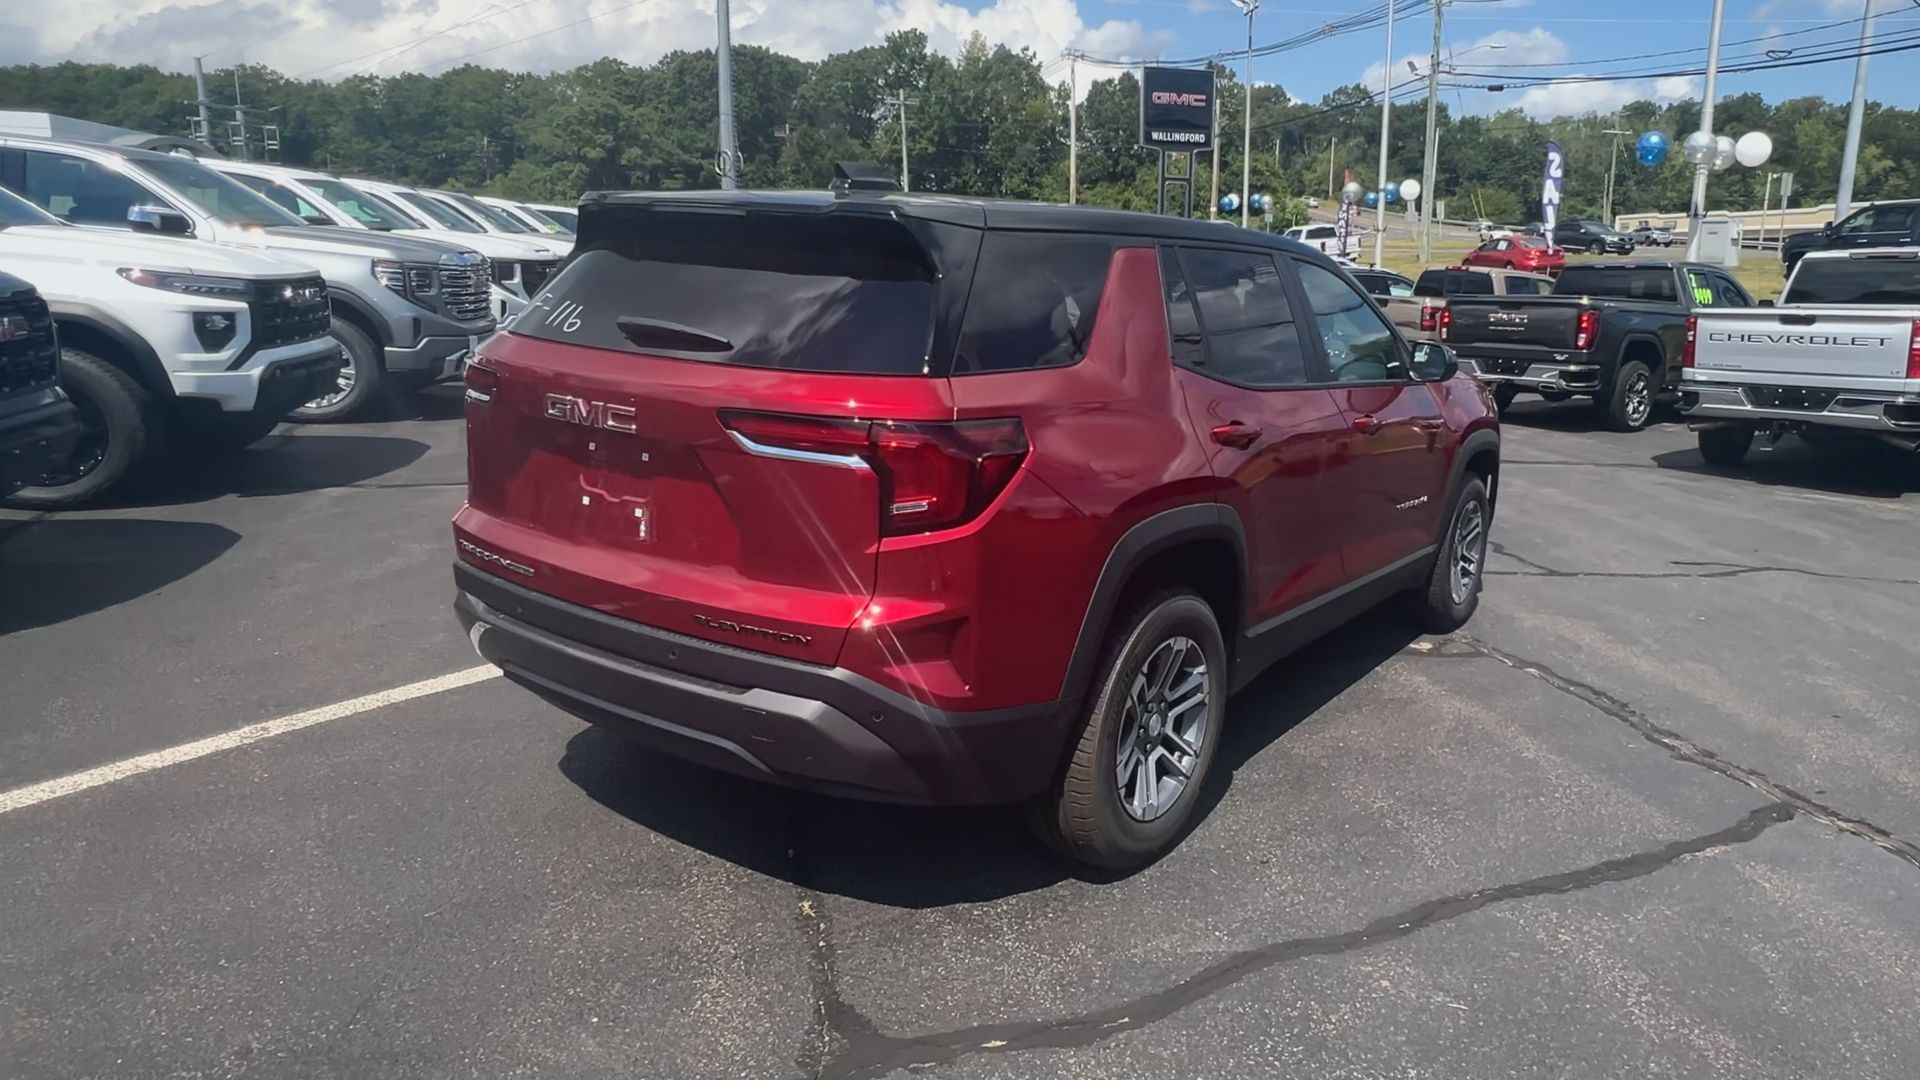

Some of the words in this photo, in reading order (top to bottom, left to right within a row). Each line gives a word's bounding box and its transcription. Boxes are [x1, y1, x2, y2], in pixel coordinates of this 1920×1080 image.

[1152, 91, 1206, 107] GMC
[1151, 131, 1206, 143] WALLINGFORD
[1708, 332, 1893, 347] CHEVROLET
[544, 393, 636, 434] GMC
